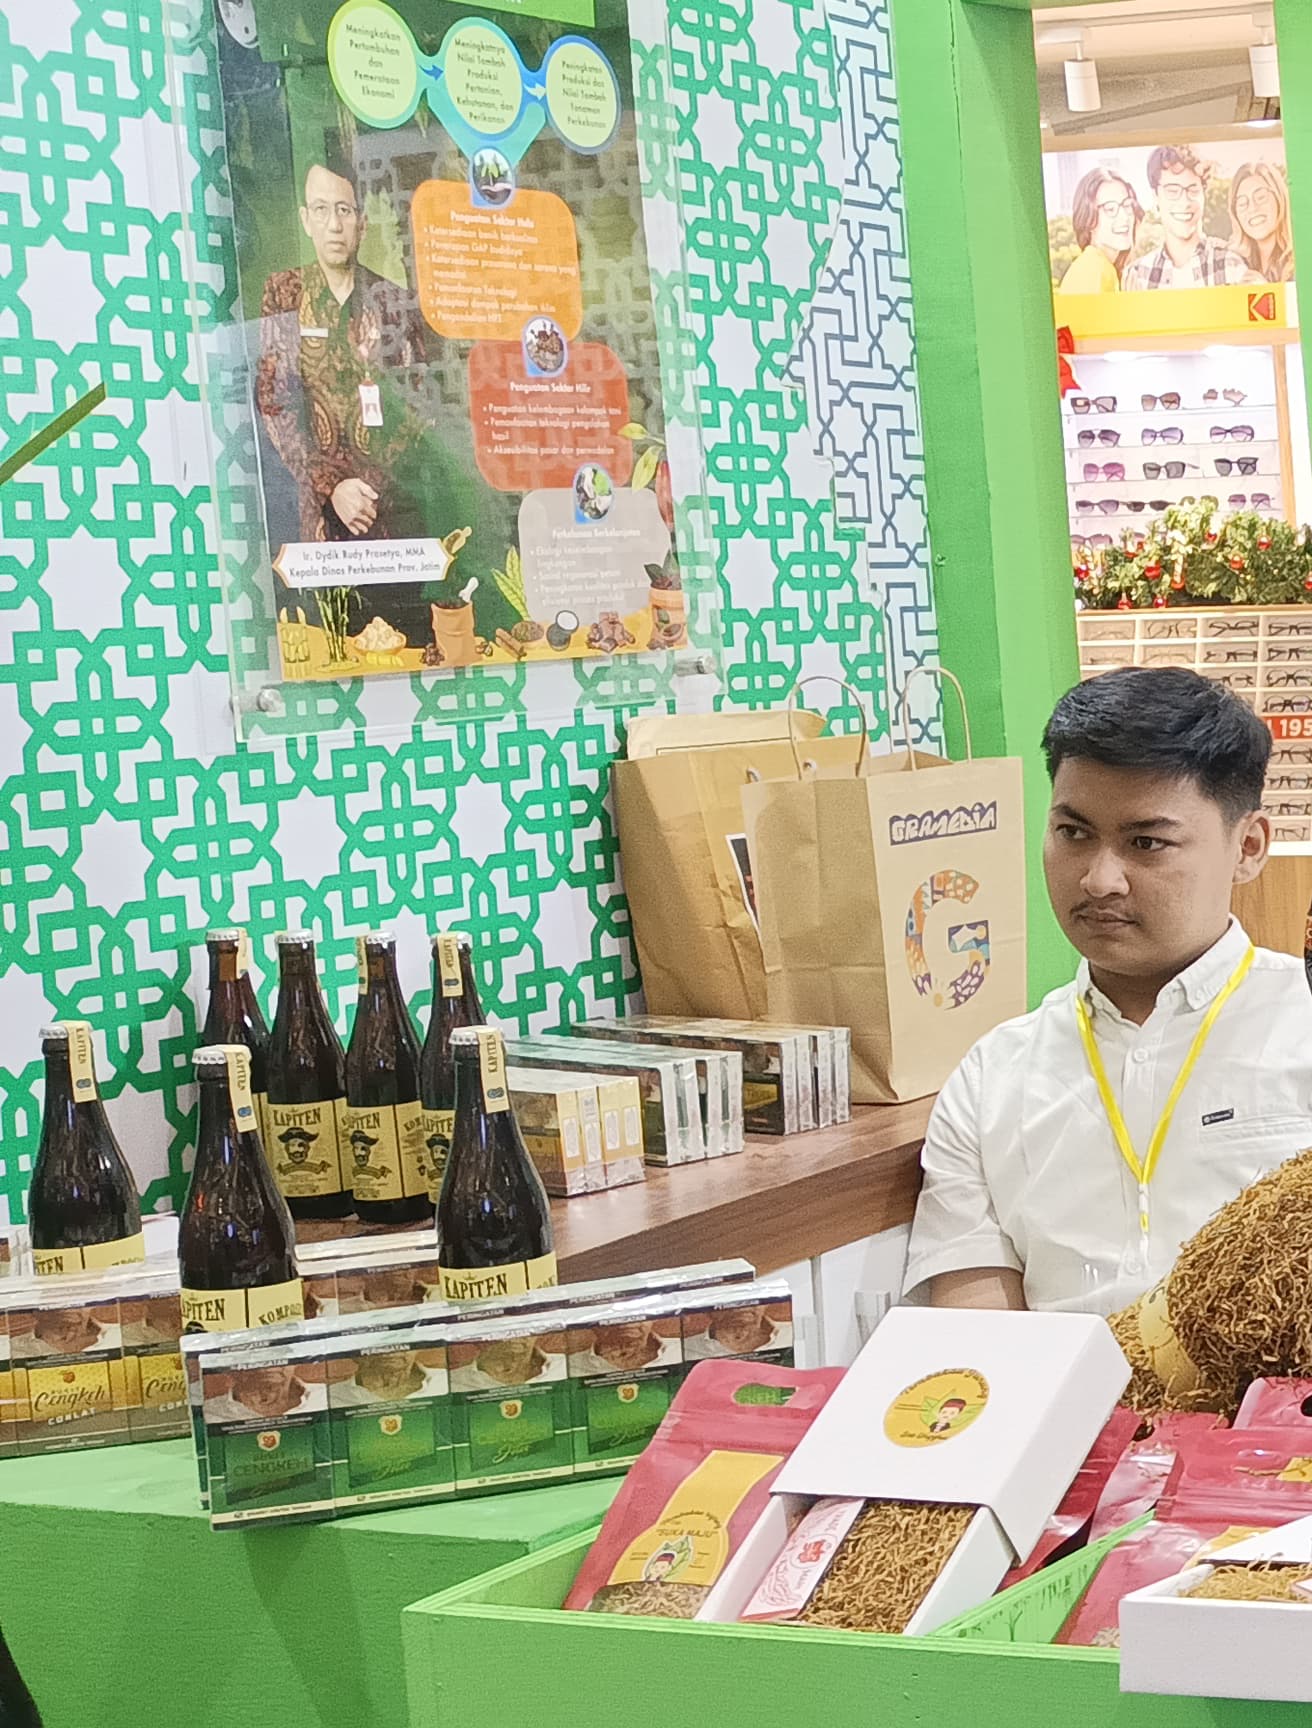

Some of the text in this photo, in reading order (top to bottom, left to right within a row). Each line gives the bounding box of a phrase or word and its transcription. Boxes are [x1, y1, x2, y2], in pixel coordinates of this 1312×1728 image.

[350, 40, 400, 56] Pertumbuhan
[468, 69, 498, 81] Produksi
[362, 86, 395, 99] Ekonomi
[343, 549, 363, 562] Rudy
[289, 566, 319, 578] Kepala
[322, 565, 345, 576] Dinas
[348, 563, 395, 575] Perkebunan
[420, 563, 440, 571] Jatim
[487, 1033, 496, 1073] KAPITEN
[273, 1107, 322, 1126] KAPITEN
[444, 1272, 508, 1300] KAPITEN
[34, 1385, 105, 1413] Cengkeh
